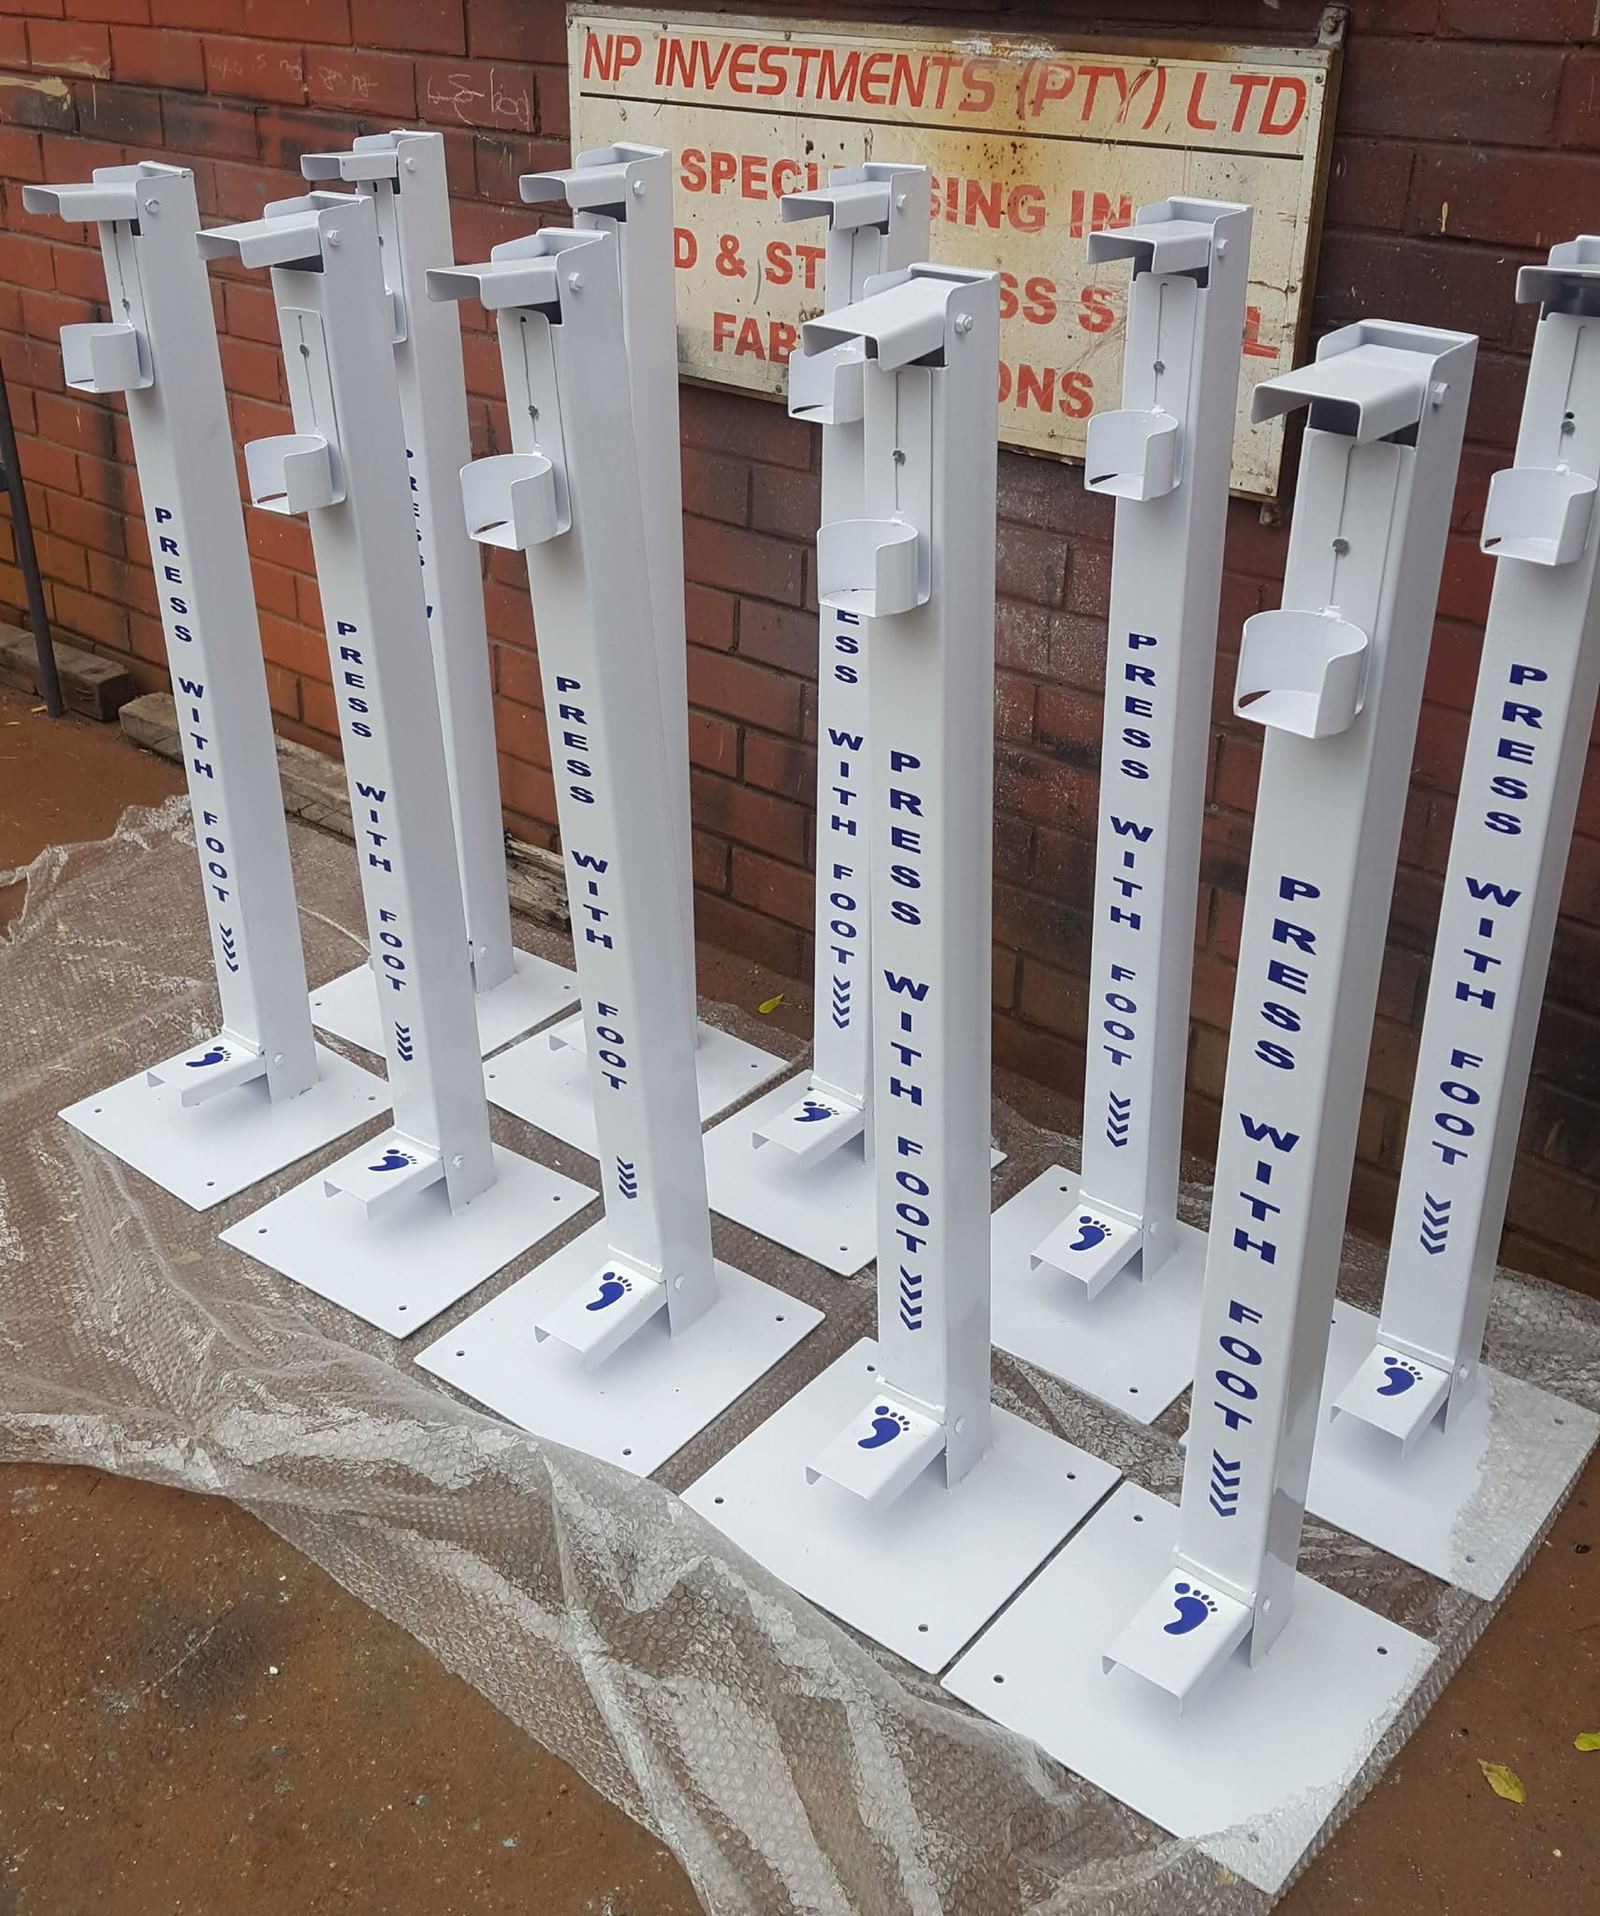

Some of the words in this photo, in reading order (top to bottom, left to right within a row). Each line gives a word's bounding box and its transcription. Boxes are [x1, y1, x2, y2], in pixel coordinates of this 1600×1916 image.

[584, 32, 642, 81] NP
[655, 37, 997, 112] INVESTMENTS
[1017, 60, 1167, 130] (PTY)
[1186, 72, 1307, 136] LTD
[715, 234, 748, 279] &
[1069, 189, 1133, 239] IN
[154, 506, 193, 643] PRESS
[179, 678, 214, 780] WITH
[202, 810, 230, 903] FOOT
[555, 675, 596, 805] PRESS
[1121, 632, 1158, 780] PRESS
[1483, 663, 1549, 836] PRESS
[336, 620, 373, 738] PRESS
[356, 781, 392, 873] WITH
[379, 908, 406, 992] FOOT
[828, 728, 864, 837] WITH
[889, 750, 924, 926] PRESS
[571, 850, 614, 950] WITH
[829, 863, 857, 965] FOOT
[1109, 815, 1154, 931] WITH
[1254, 875, 1321, 1071] PRESS
[1454, 876, 1522, 1011] WITH
[596, 1001, 627, 1091] FOOT
[883, 969, 930, 1107] WITH
[1102, 963, 1138, 1067] FOOT
[1431, 1047, 1484, 1166] FOOT
[895, 1136, 930, 1254] FOOT
[1232, 1112, 1301, 1266] WITH
[1214, 1299, 1264, 1432] FOOT
